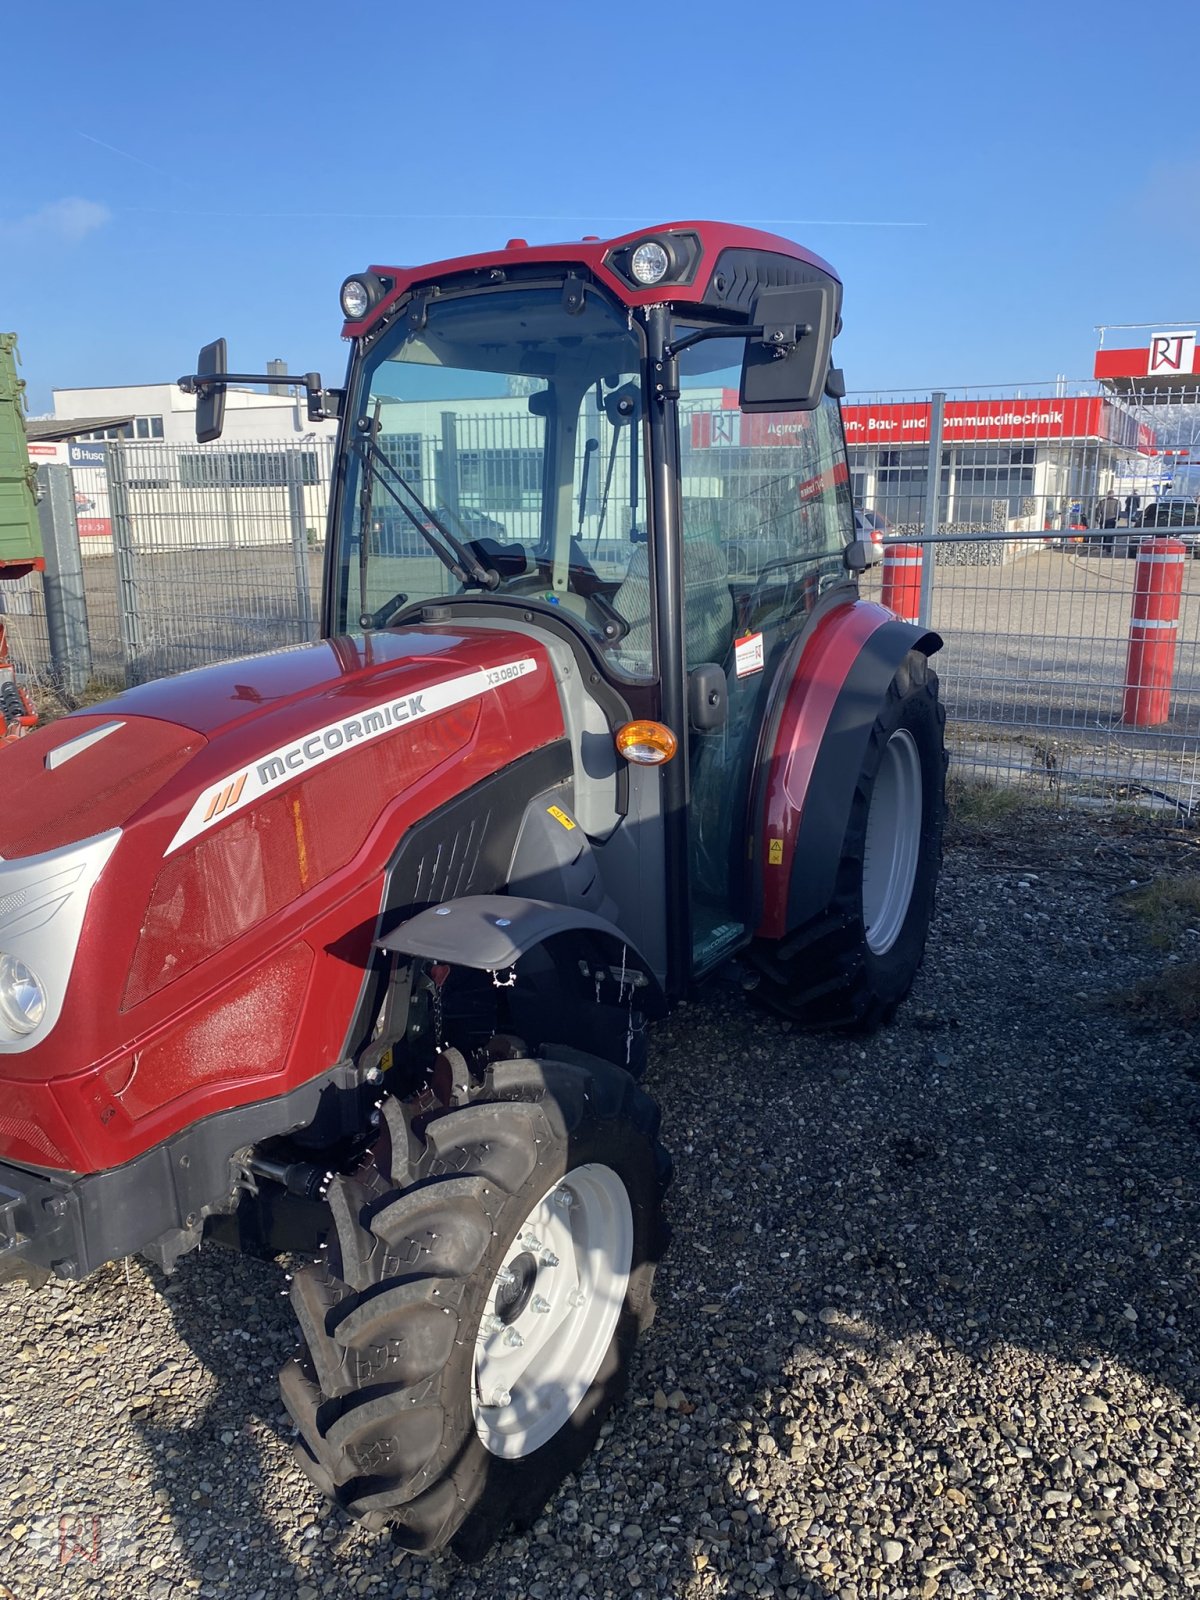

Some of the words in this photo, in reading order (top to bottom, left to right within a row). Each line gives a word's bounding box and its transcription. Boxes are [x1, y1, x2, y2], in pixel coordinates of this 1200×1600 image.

[1151, 336, 1193, 370] RT
[868, 417, 898, 430] Bau-
[902, 416, 928, 429] und
[943, 411, 1063, 427] ommunaltechnik
[82, 450, 105, 462] Husq
[486, 665, 519, 685] X3.080
[519, 663, 526, 675] F
